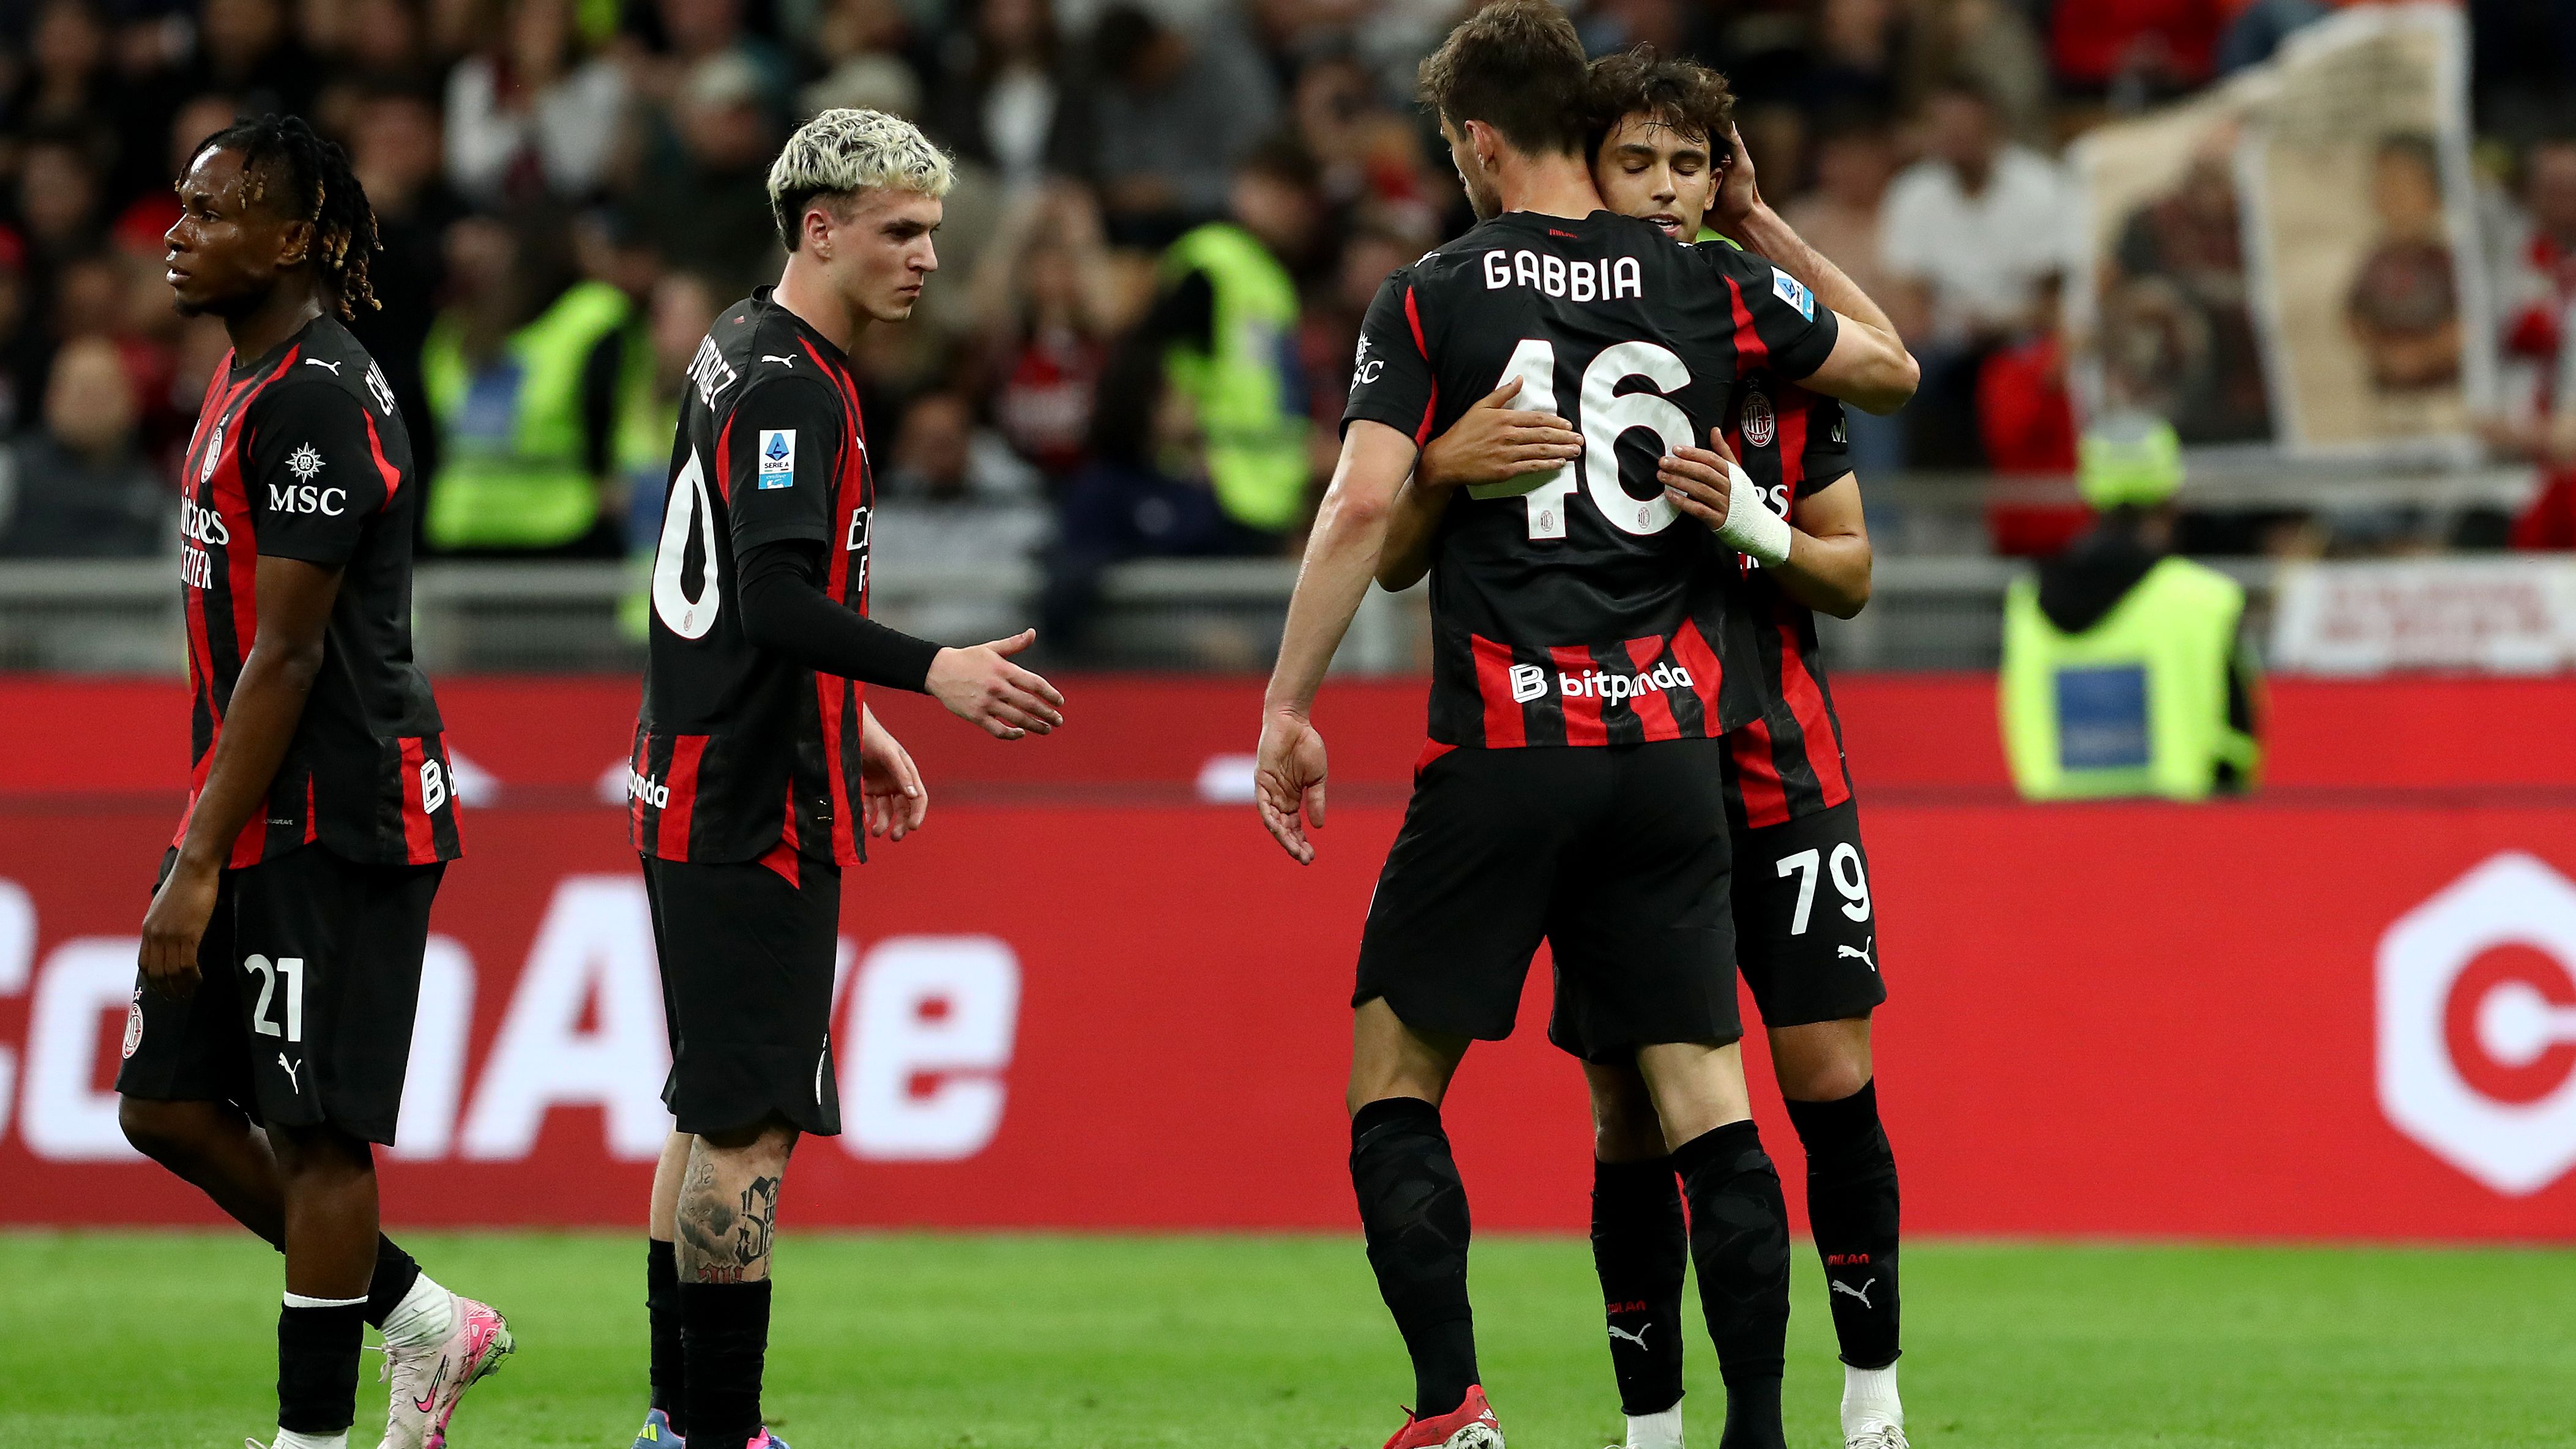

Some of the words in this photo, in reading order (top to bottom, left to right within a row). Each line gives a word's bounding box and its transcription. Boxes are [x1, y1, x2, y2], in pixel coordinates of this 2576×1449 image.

[1484, 250, 1641, 302] GABBIA
[1350, 360, 1384, 395] SC
[1466, 339, 1695, 540] 46
[268, 483, 346, 516] MSC
[1559, 661, 1695, 707] bitpanda
[1775, 841, 1871, 936] 79
[244, 953, 304, 1043] 21
